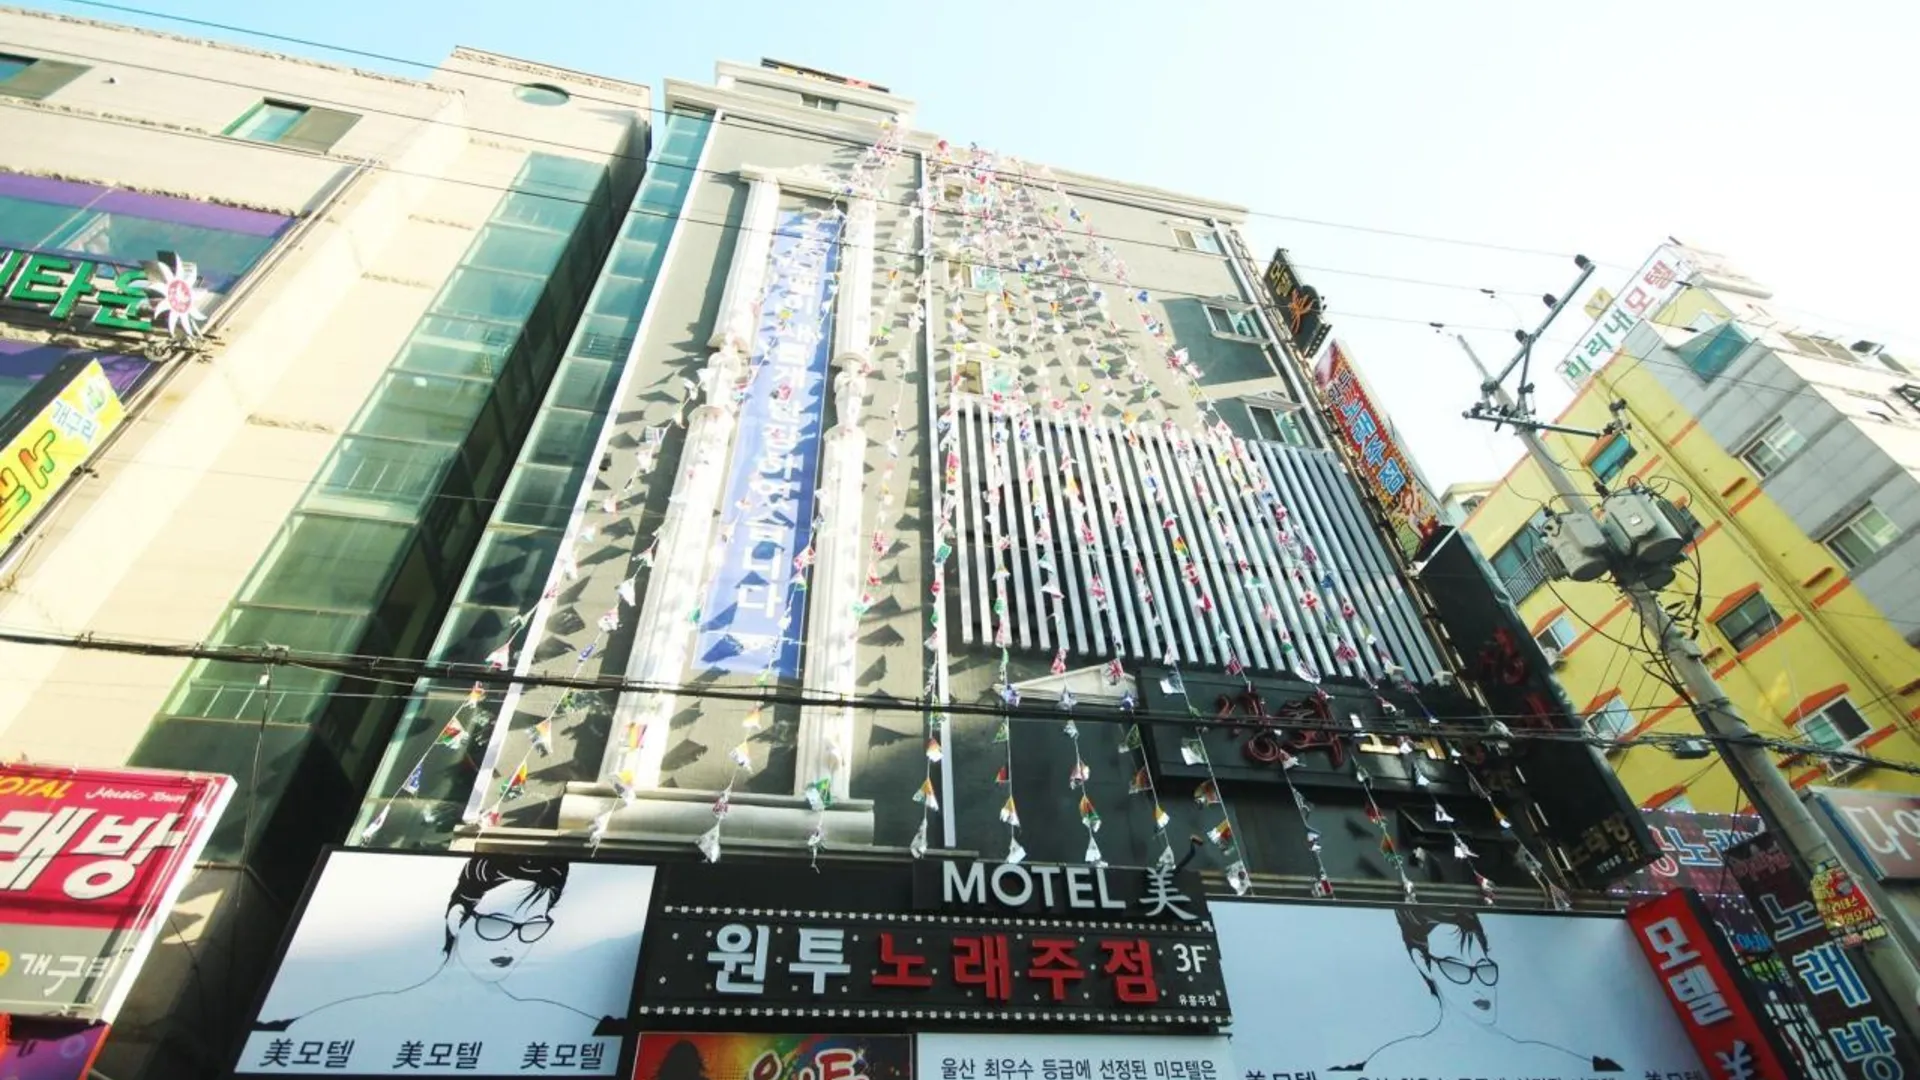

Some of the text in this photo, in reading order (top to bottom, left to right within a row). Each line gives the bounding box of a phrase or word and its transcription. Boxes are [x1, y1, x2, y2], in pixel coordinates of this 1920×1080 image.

[52, 400, 98, 443] 개구리
[0, 775, 73, 800] OTAL
[942, 860, 1198, 920] MOTEL 美
[1173, 943, 1206, 973] 3F
[1644, 916, 1733, 1026] 모텔
[1178, 994, 1218, 1007] 유흥주점
[1760, 893, 1904, 1080] 노래방
[259, 1038, 604, 1071] 美모텔 美모텔 美모텔
[940, 1057, 1217, 1080] 울산 최우수 등급에 선정된 미모텔은
